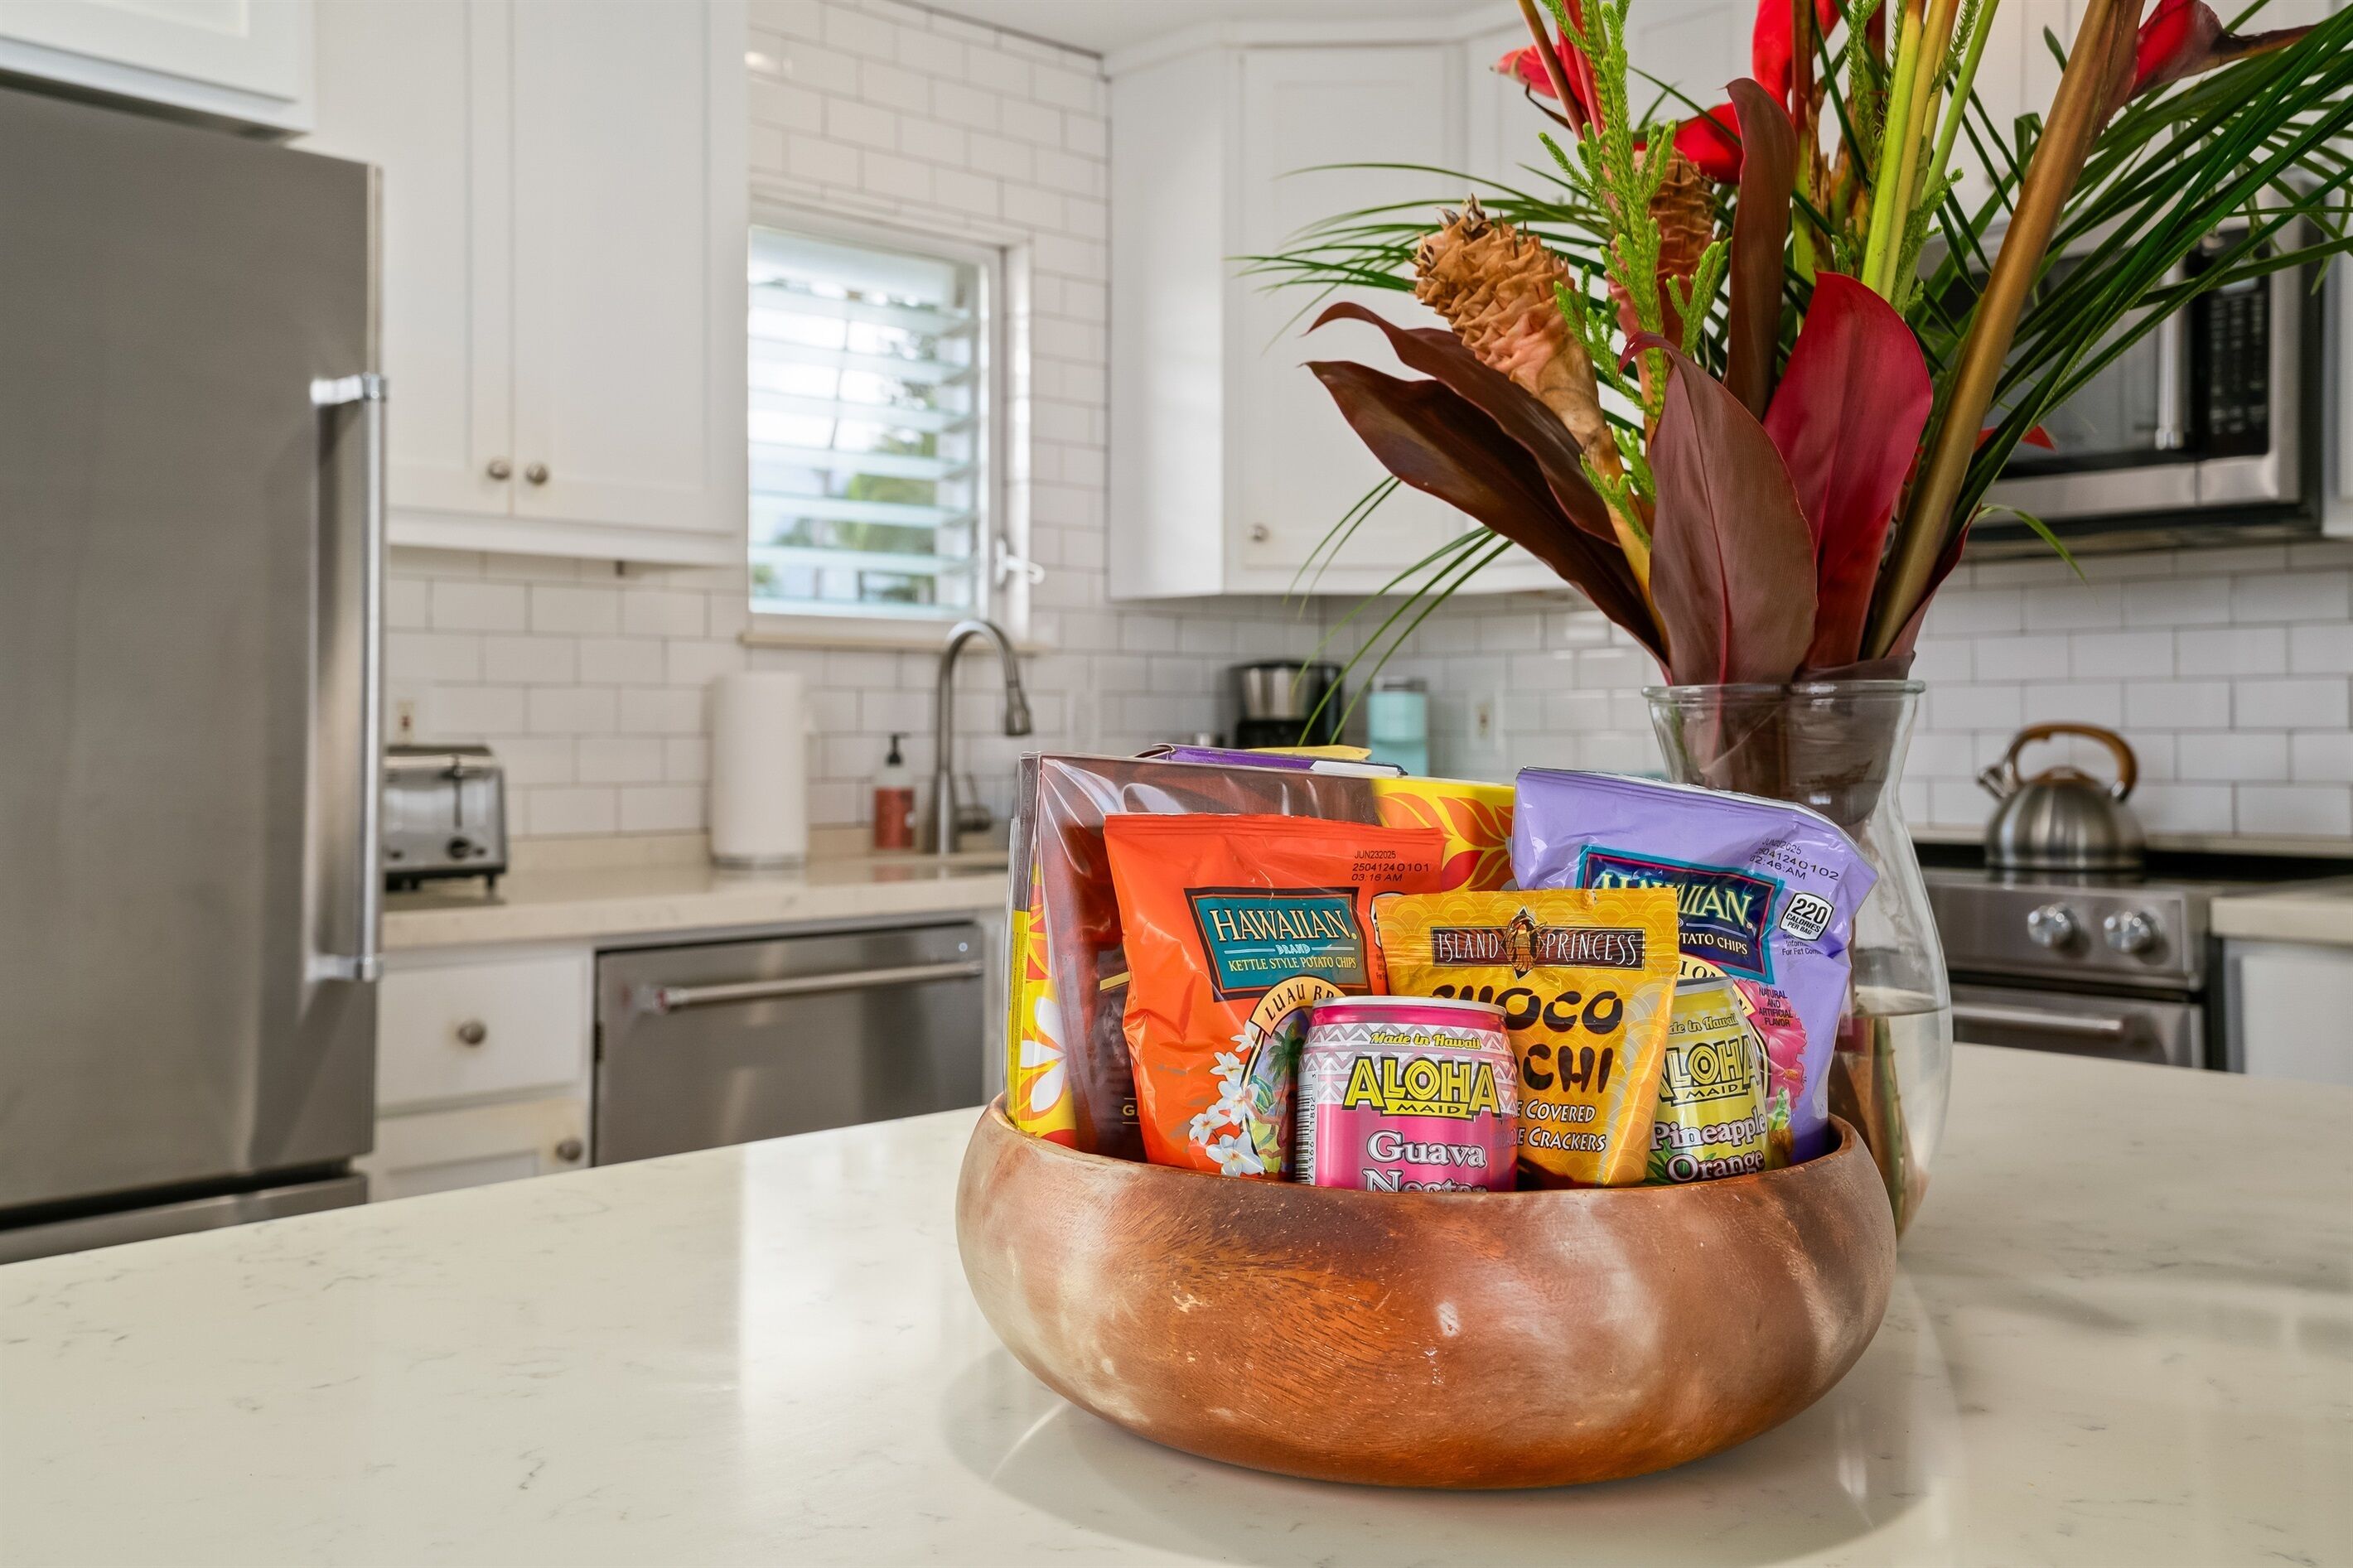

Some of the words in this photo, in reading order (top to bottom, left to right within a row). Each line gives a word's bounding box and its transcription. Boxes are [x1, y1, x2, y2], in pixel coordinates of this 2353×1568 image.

[1354, 851, 1397, 859] JUN232025
[1352, 862, 1429, 872] 25041240101
[1351, 873, 1382, 881] 03:16
[1384, 873, 1403, 882] AM
[1790, 898, 1829, 924] 220
[1209, 908, 1352, 941] HAWAIIAN
[1785, 913, 1822, 933] CALORIES
[1787, 921, 1800, 930] PER
[1800, 927, 1813, 935] BAG
[1275, 943, 1311, 955] BRAND
[1438, 933, 1499, 963] ISLAND
[1545, 933, 1637, 965] PRINCESS
[1679, 932, 1714, 945] TATO
[1717, 937, 1748, 954] CHIPS
[1228, 958, 1268, 972] KETTLE
[1269, 958, 1300, 969] STYLE
[1302, 957, 1334, 969] POTATO
[1336, 957, 1357, 969] CHIPS
[1264, 983, 1306, 1021] LUAU
[1759, 987, 1788, 999] NATURAL
[1766, 998, 1780, 1008] AND
[1759, 1006, 1794, 1018] ARTIFICIAL
[1668, 1021, 1686, 1035] de
[1687, 1020, 1703, 1032] in
[1703, 1013, 1739, 1030] Hawaii
[1764, 1017, 1791, 1028] FLAVOR
[1370, 1030, 1411, 1045] Made
[1413, 1033, 1430, 1046] in
[1433, 1033, 1482, 1050] Hawaii
[1515, 1043, 1614, 1093] CHI
[1341, 1056, 1502, 1117] ALOHA
[1685, 1083, 1738, 1099] MAID
[1396, 1103, 1461, 1114] MAID
[1525, 1098, 1596, 1123] COVERED
[1650, 1106, 1767, 1151] Pineapple
[1366, 1129, 1488, 1169] Guava
[1528, 1127, 1607, 1152] CRACKERS
[1665, 1150, 1766, 1183] Orange
